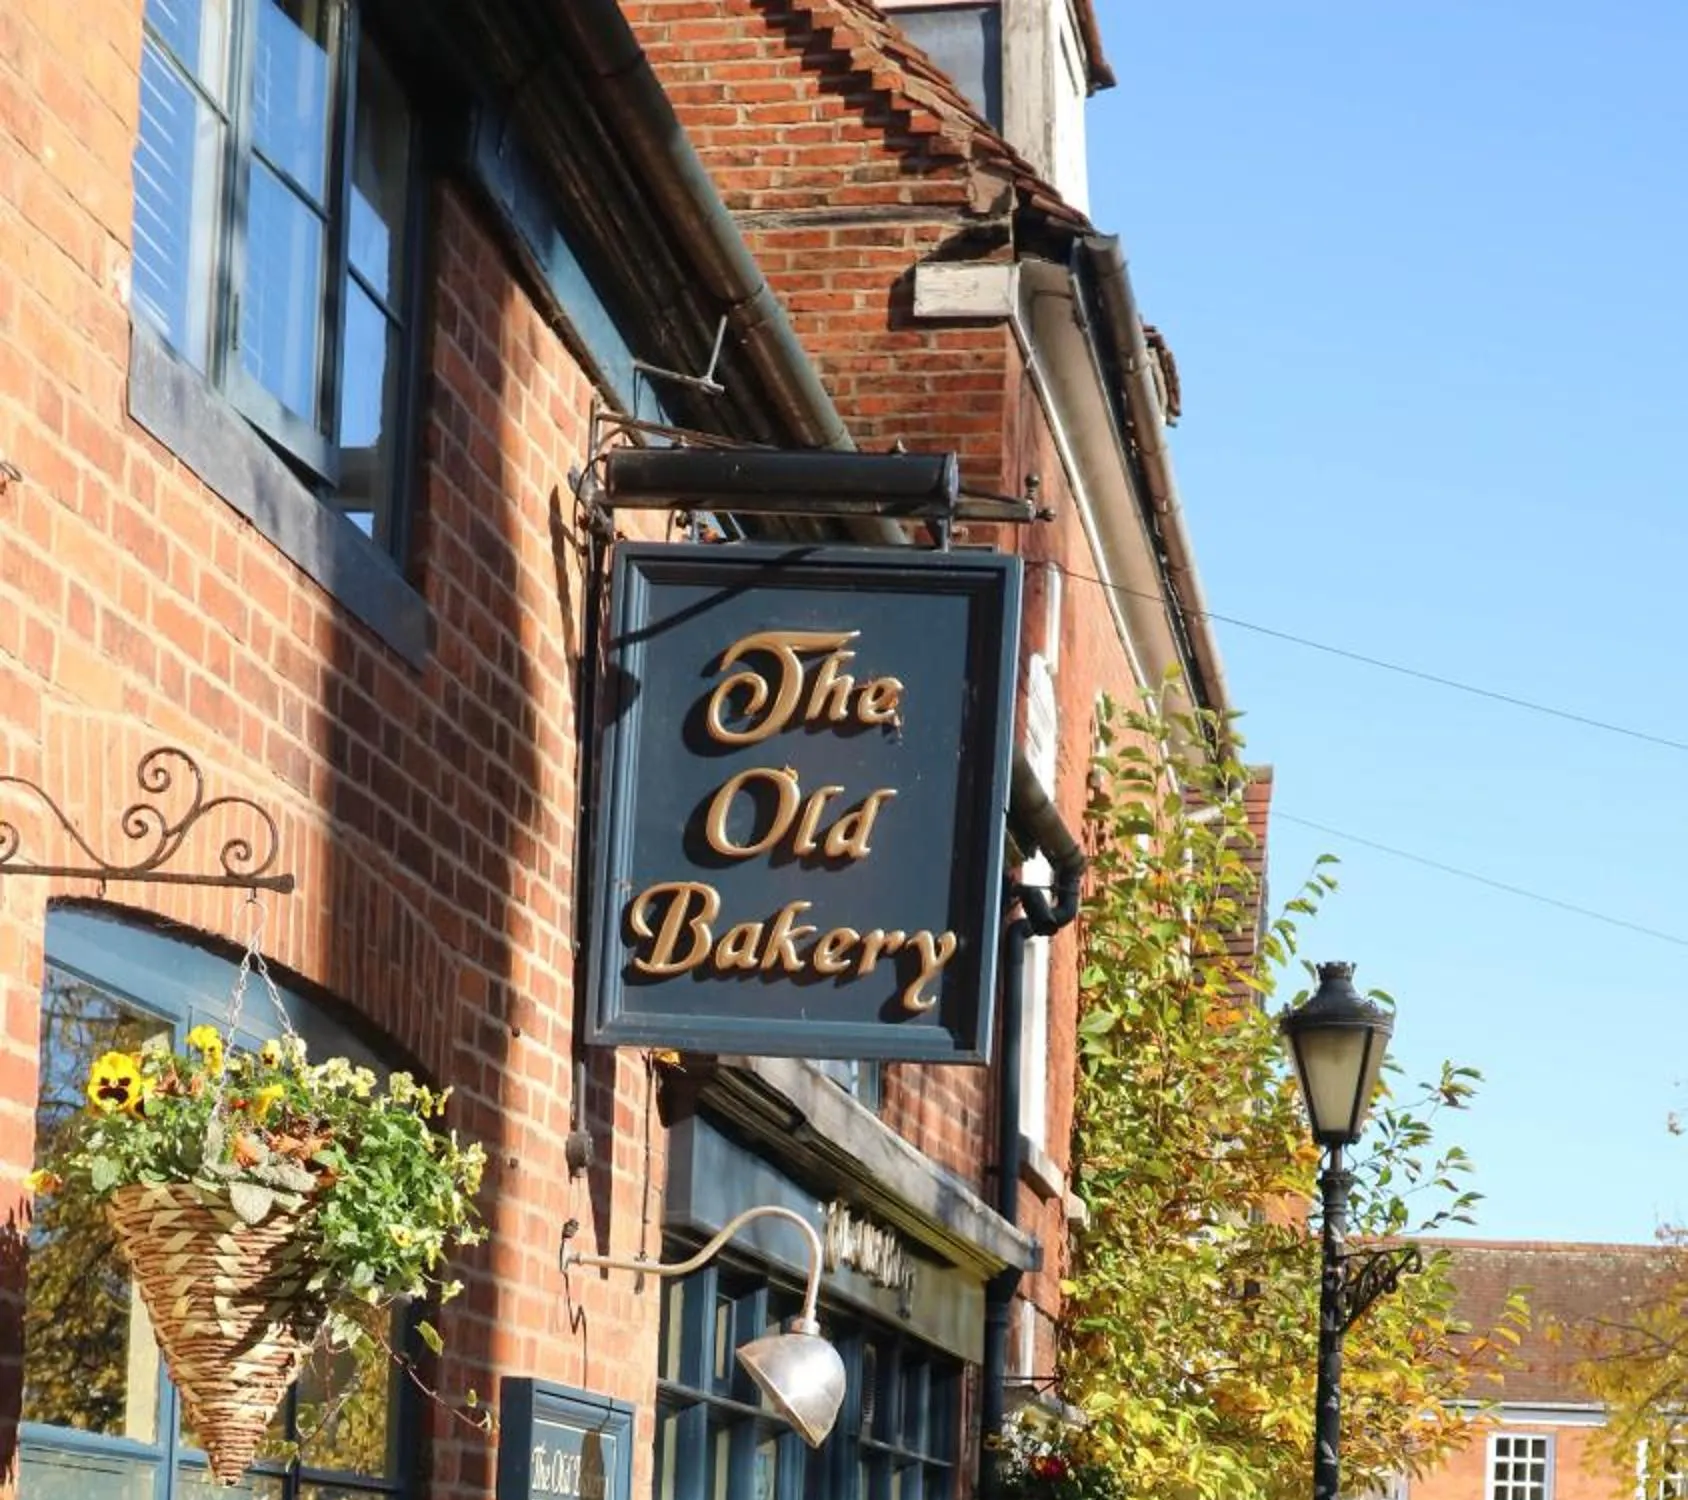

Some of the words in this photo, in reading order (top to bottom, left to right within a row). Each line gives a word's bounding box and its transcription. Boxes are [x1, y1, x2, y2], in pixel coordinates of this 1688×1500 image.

[706, 630, 905, 744] The
[705, 767, 897, 859] Old
[631, 882, 957, 1011] Bakery
